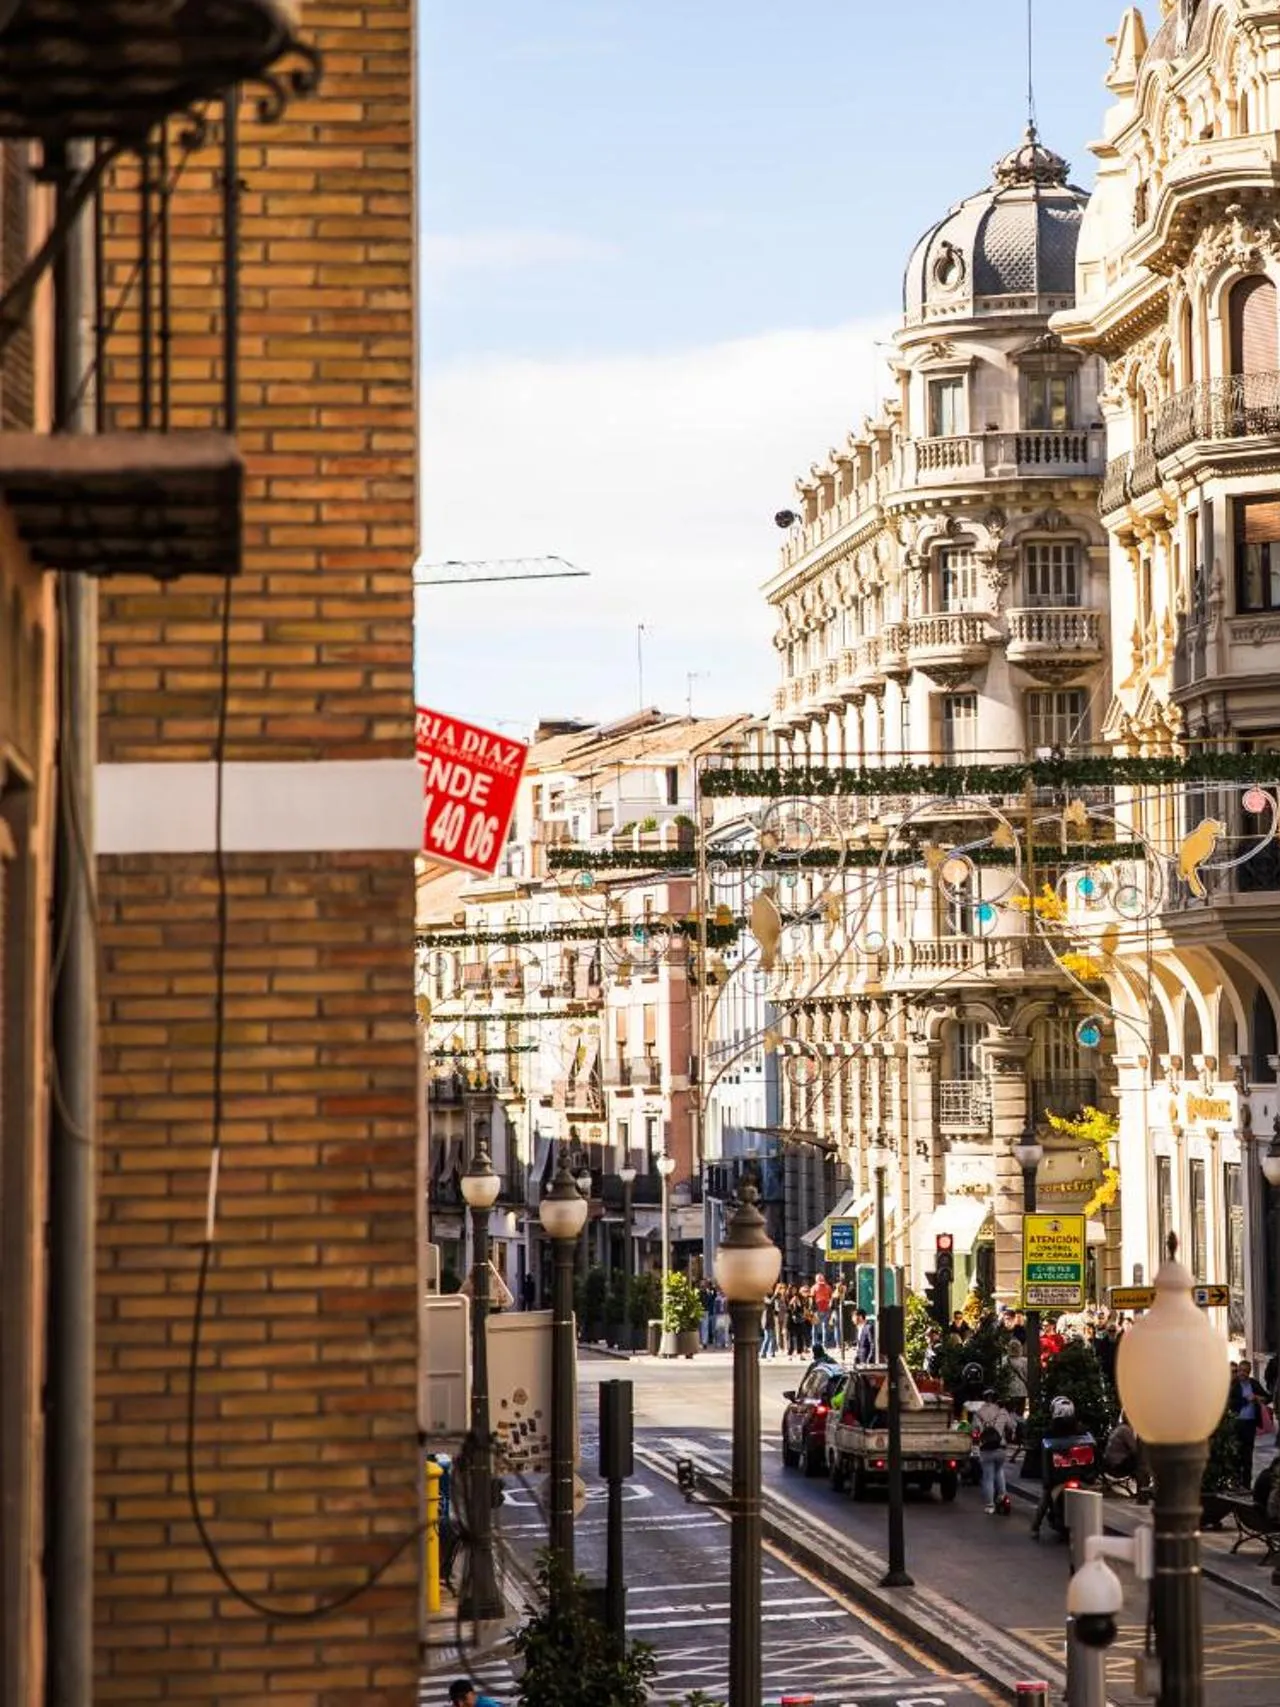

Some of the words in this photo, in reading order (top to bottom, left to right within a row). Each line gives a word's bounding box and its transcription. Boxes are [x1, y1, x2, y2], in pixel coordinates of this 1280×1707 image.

[461, 731, 521, 768] DIAZ
[431, 799, 466, 852] 40
[464, 810, 499, 863] 06
[1030, 1234, 1080, 1244] ATENCIÓN
